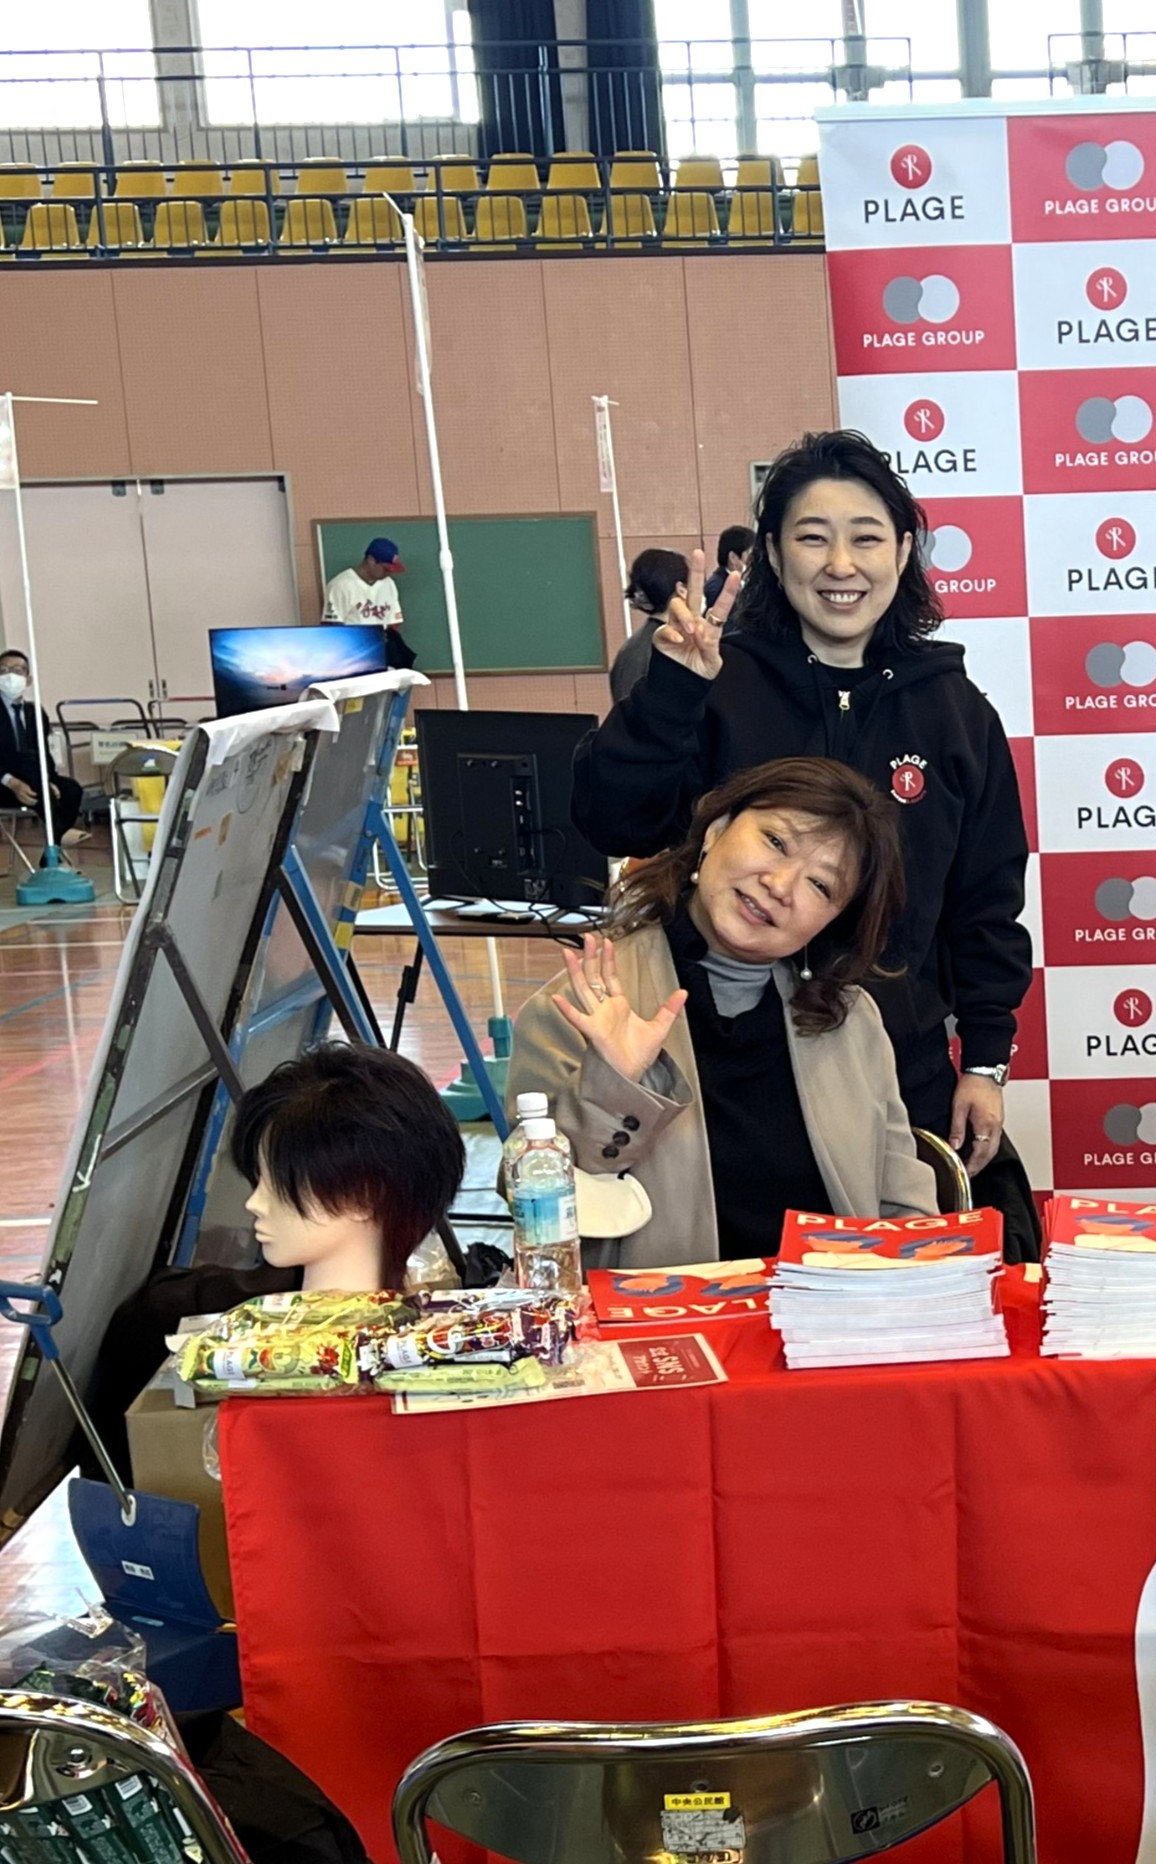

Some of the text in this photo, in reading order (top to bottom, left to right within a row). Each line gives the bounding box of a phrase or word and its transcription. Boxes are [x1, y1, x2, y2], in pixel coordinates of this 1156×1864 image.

[864, 195, 965, 224] PLAGE
[1044, 198, 1099, 215] PLAGE
[863, 330, 985, 348] PLAGE GROUP
[1055, 451, 1109, 467] PLAGE
[934, 578, 997, 594] GROUP
[1065, 695, 1118, 710] PLAGE
[889, 753, 928, 770] PLAGE
[1075, 928, 1127, 942] PLAGE
[1083, 1152, 1135, 1167] PLAGE
[796, 1209, 984, 1232] PLAGE
[607, 1297, 769, 1319] LAGE
[671, 1796, 725, 1807] 中央公民館
